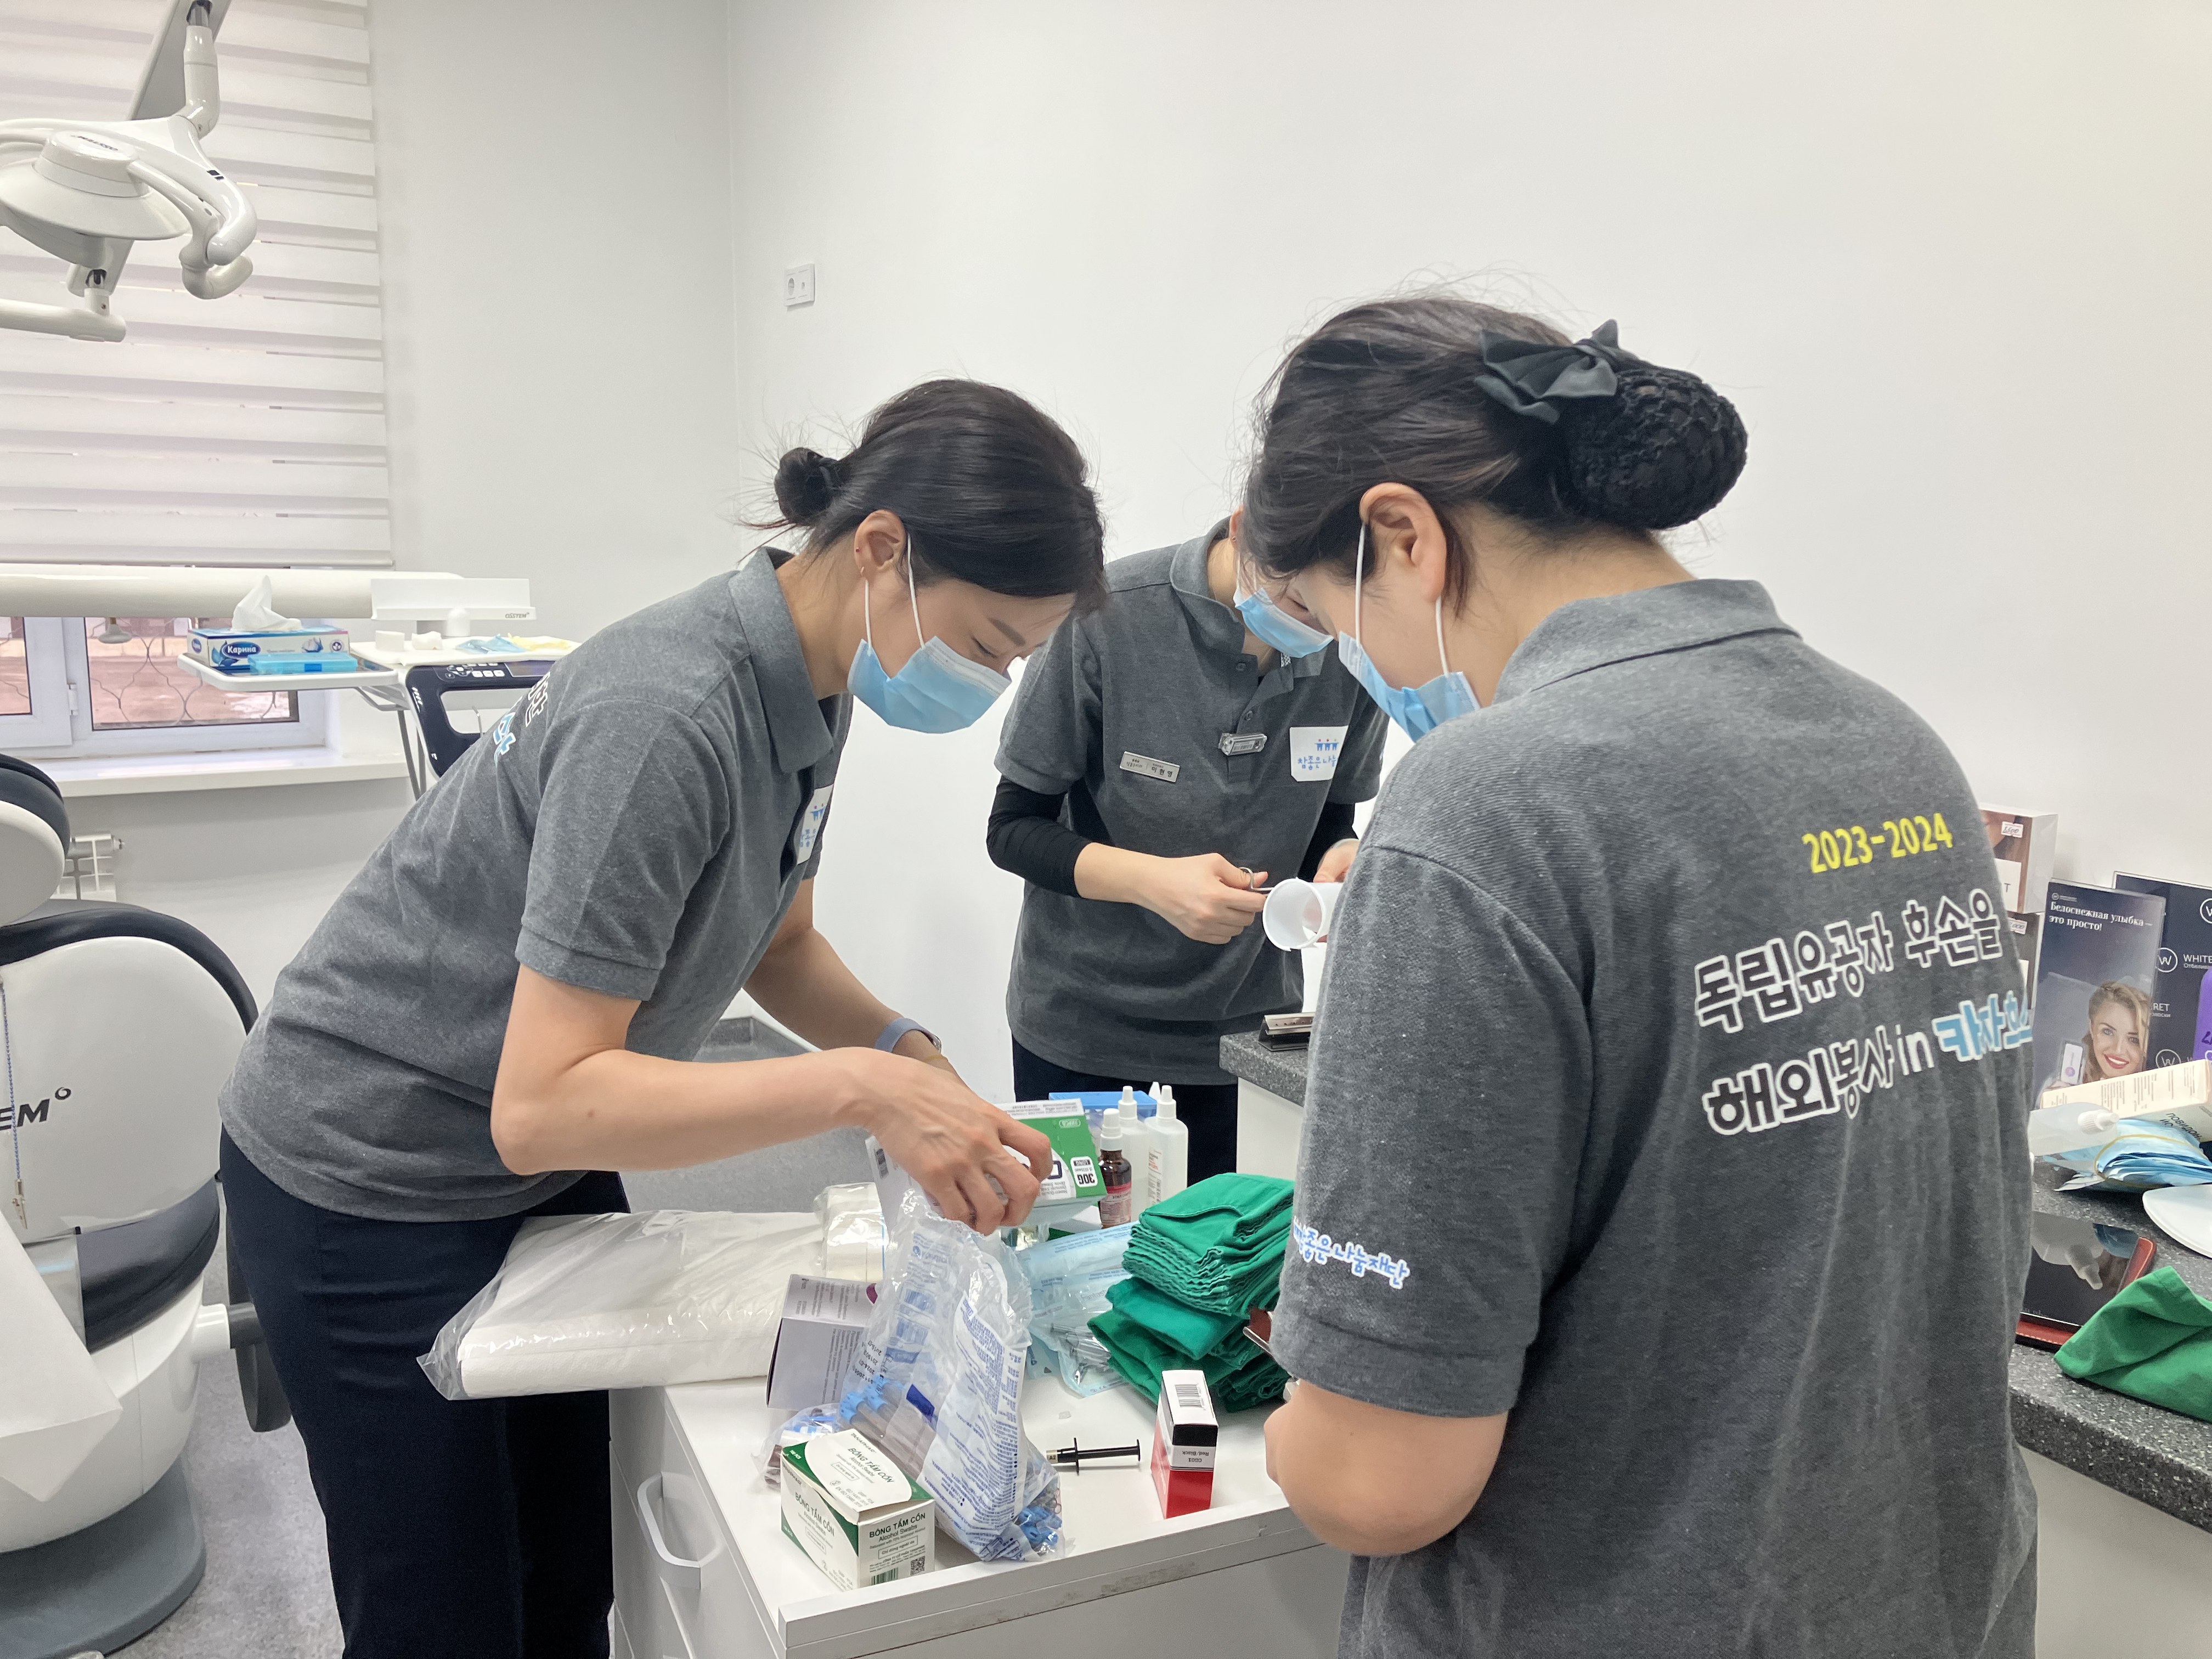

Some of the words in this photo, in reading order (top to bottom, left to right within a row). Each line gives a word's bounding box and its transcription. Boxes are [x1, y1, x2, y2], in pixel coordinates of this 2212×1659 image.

[227, 645, 257, 655] Карина
[1802, 812, 1953, 873] 2023-2024
[2049, 915, 2064, 924] это
[2067, 917, 2102, 931] просто!
[2051, 901, 2109, 920] Белоснежная
[2111, 914, 2144, 927] улыбка
[1694, 911, 1893, 1034] 독립유공자
[1903, 888, 2002, 968] 후손을
[1702, 1025, 1893, 1135] 해외봉사
[1895, 1025, 1934, 1076] in
[1077, 1173, 1095, 1184] 30G
[879, 1531, 899, 1542] Alcohol
[900, 1525, 917, 1534] Swabs
